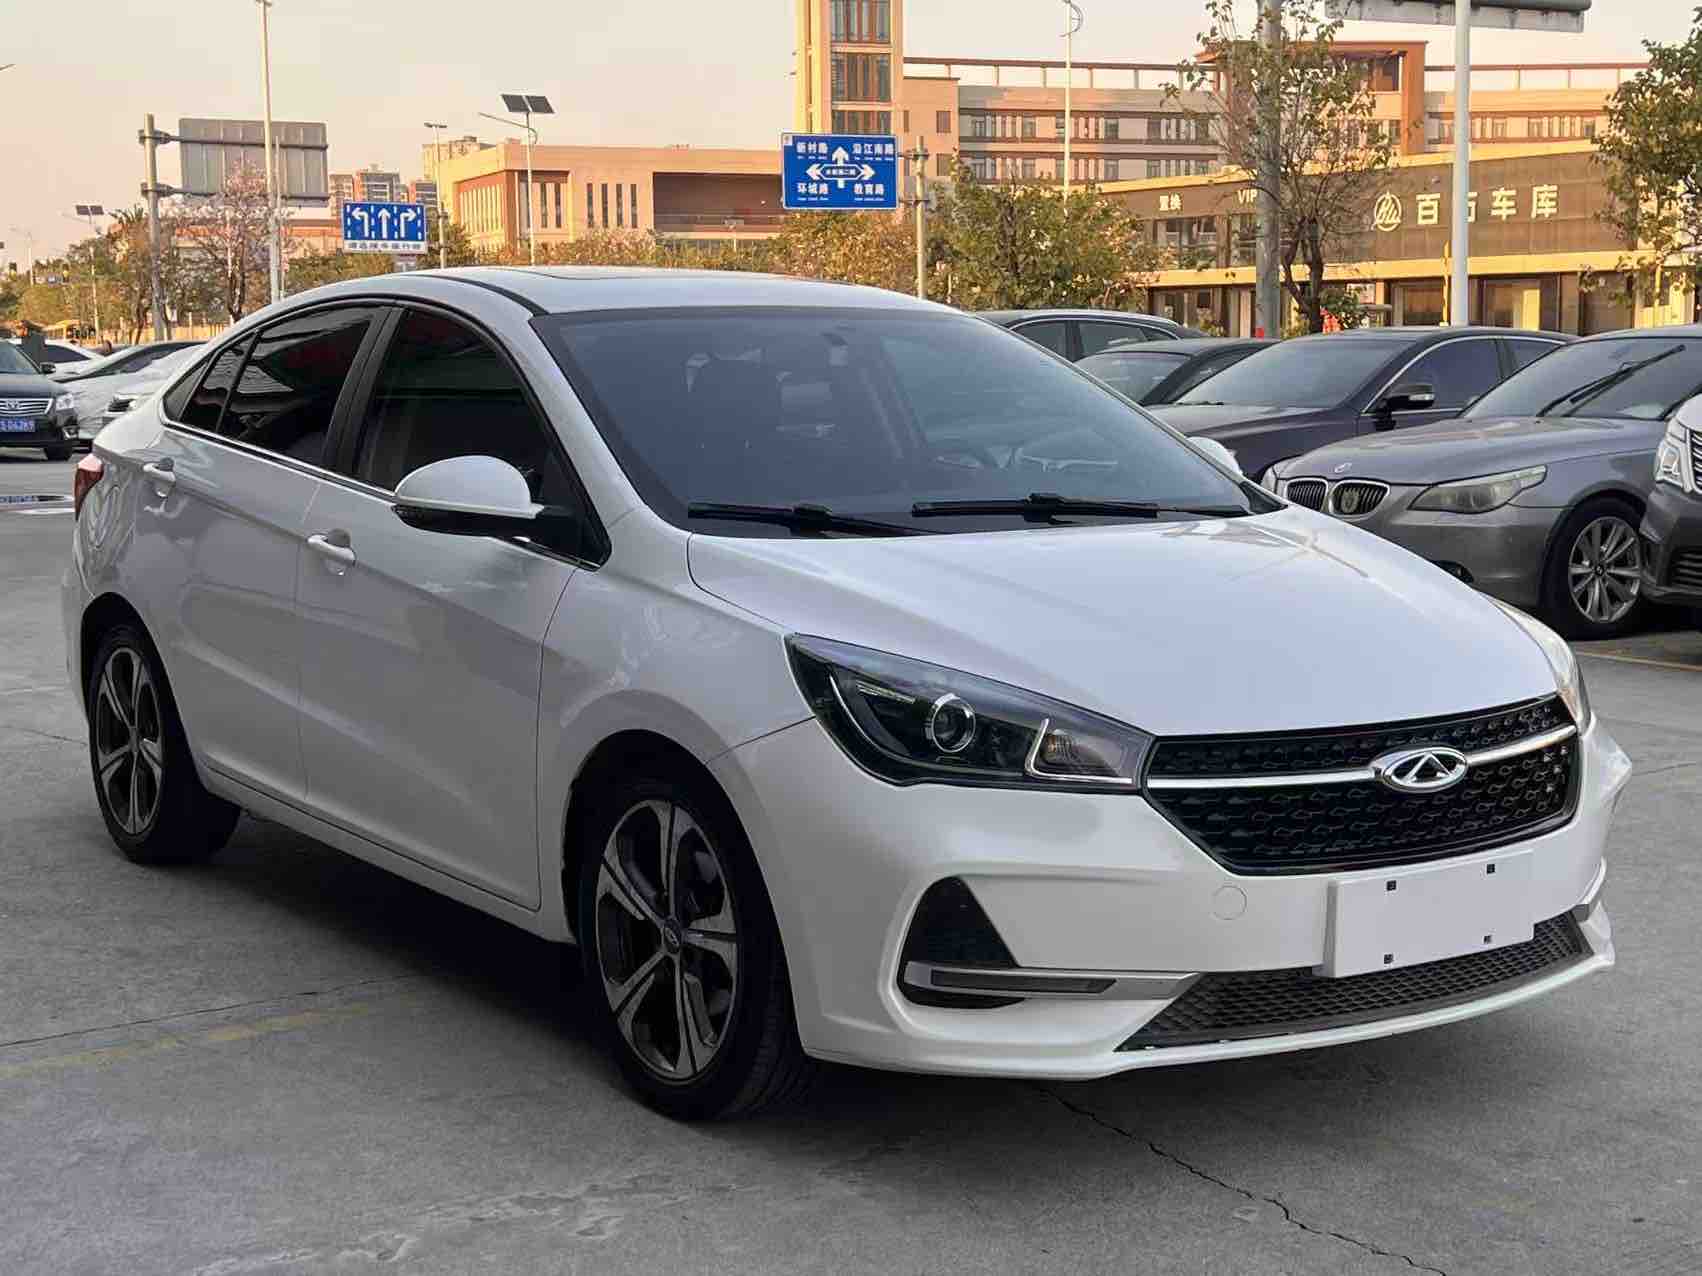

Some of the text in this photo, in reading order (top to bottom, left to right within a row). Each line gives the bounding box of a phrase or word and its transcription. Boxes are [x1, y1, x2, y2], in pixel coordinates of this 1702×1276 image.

[796, 142, 829, 154] 新村路
[852, 142, 895, 155] 沿江南路
[796, 182, 829, 195] 环城路
[854, 182, 885, 195] 教育路
[1237, 189, 1258, 204] VIP
